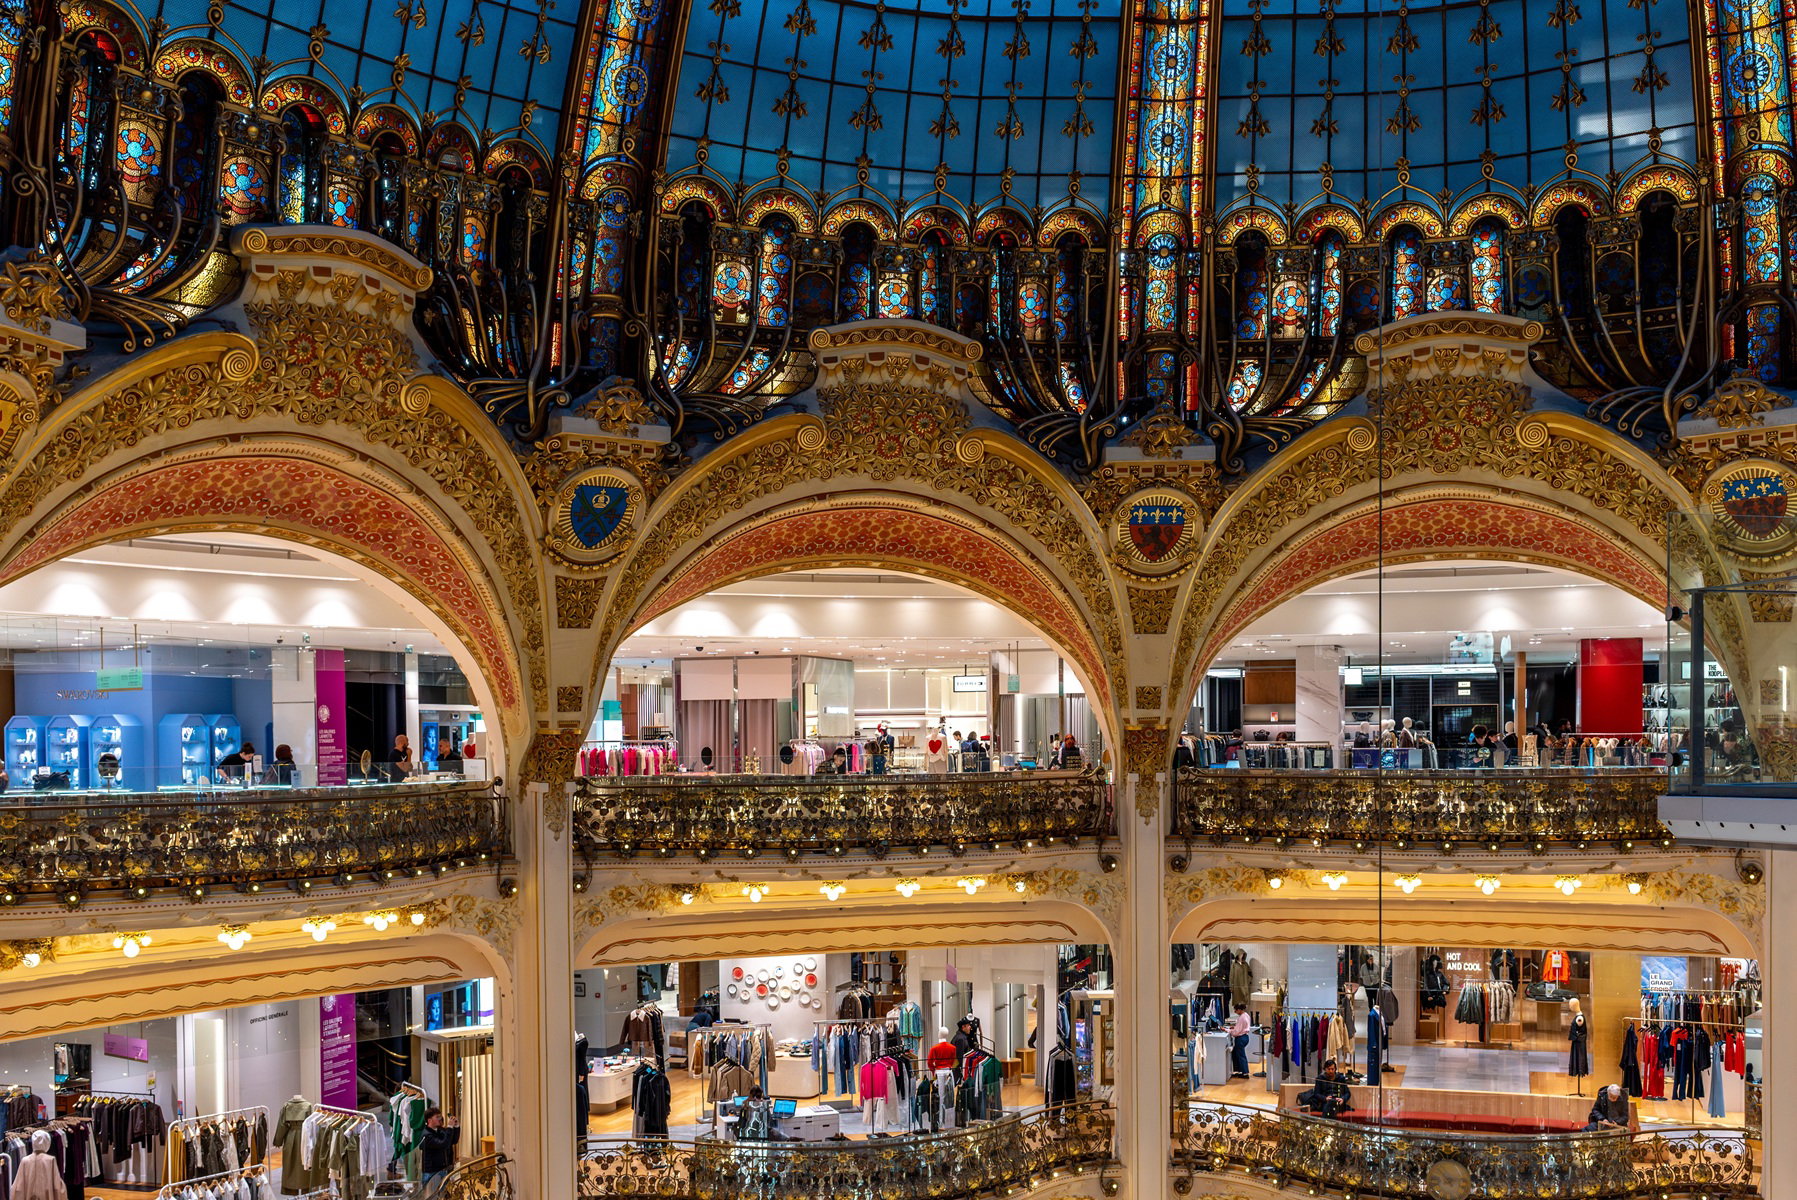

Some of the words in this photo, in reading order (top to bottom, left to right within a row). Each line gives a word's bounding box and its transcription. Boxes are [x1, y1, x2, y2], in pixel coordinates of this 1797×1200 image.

[56, 689, 110, 700] SWAROVSKI
[1446, 952, 1461, 961] HOT
[1446, 962, 1462, 970] AND
[1463, 962, 1482, 971] COOL
